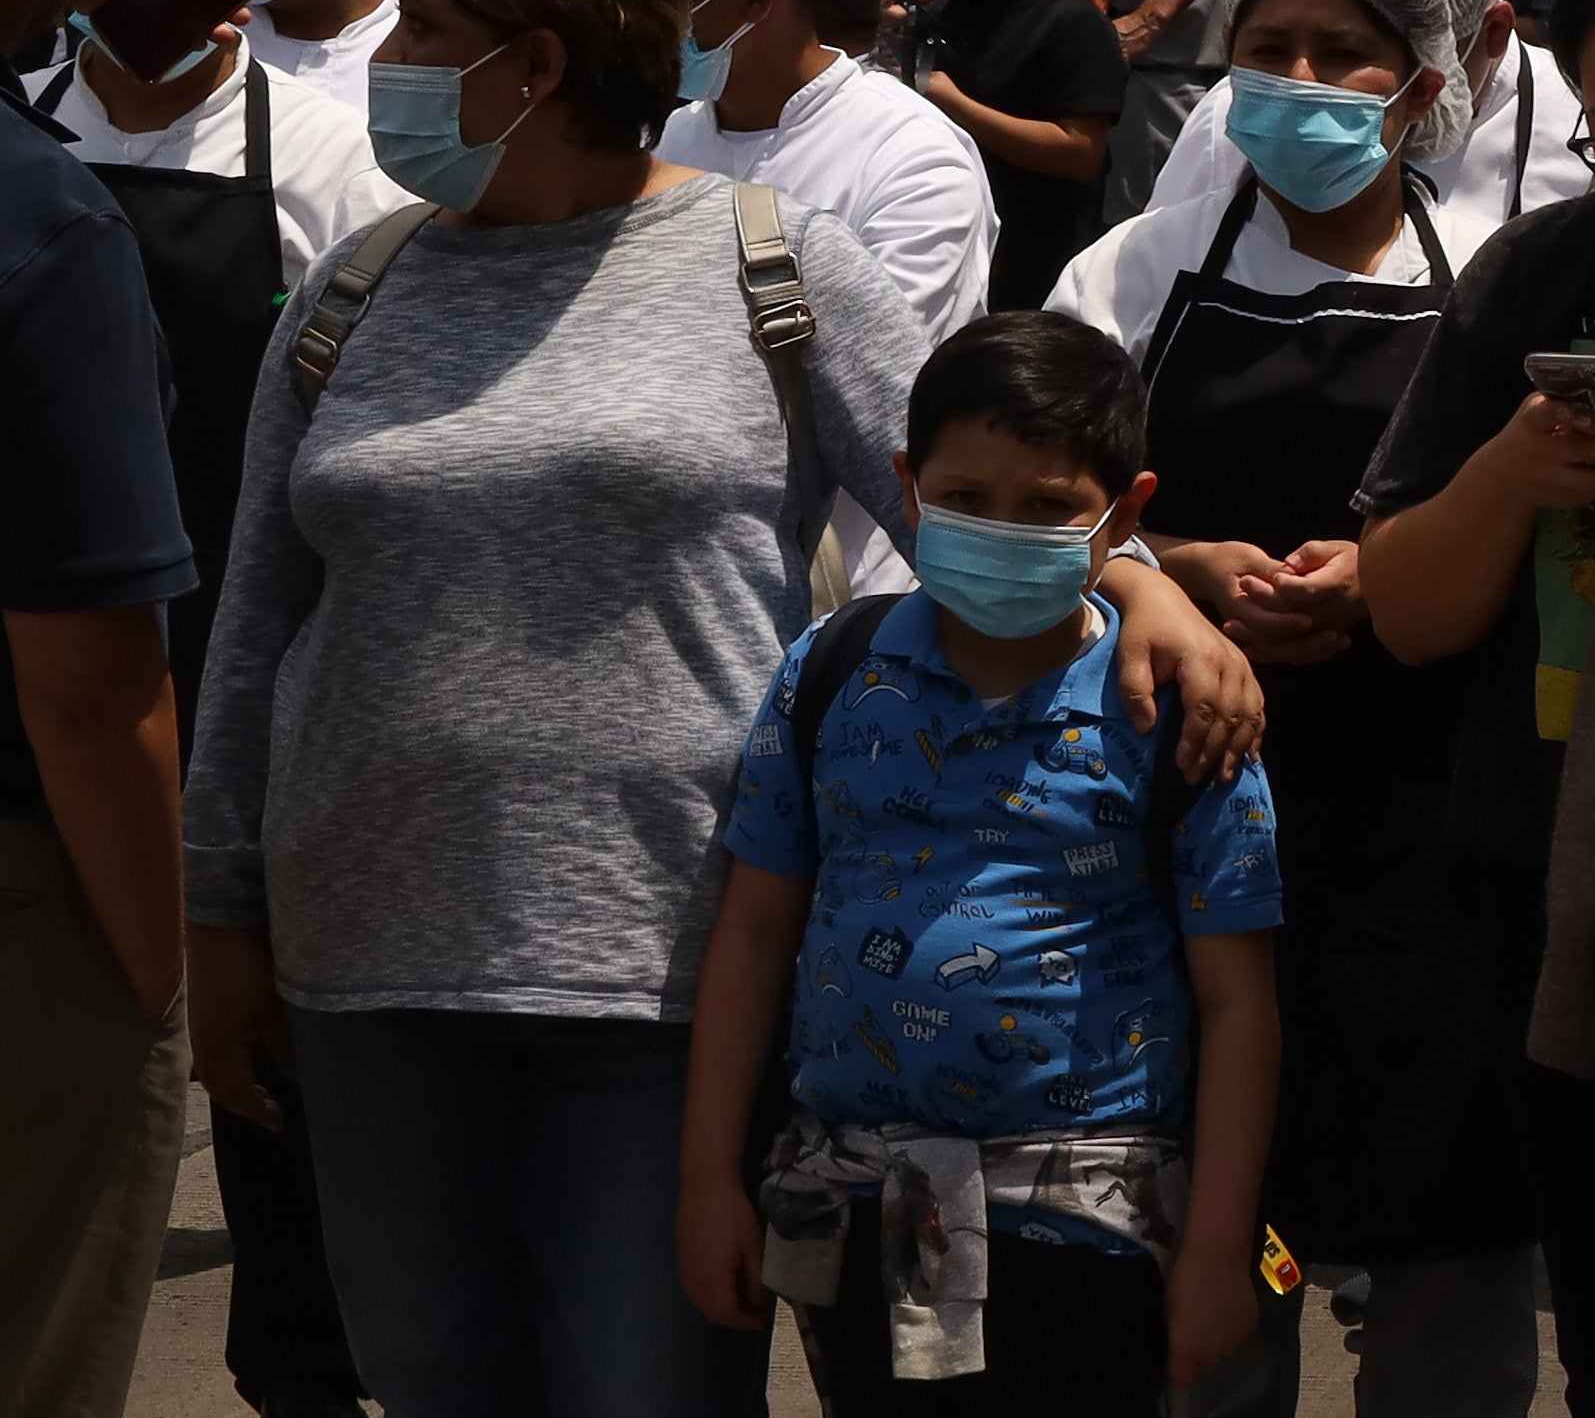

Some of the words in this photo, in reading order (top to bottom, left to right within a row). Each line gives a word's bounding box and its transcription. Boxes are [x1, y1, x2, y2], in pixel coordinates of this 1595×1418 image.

[973, 828, 1010, 843] TRY
[918, 899, 995, 920] CONTROL
[892, 999, 952, 1028] GAME
